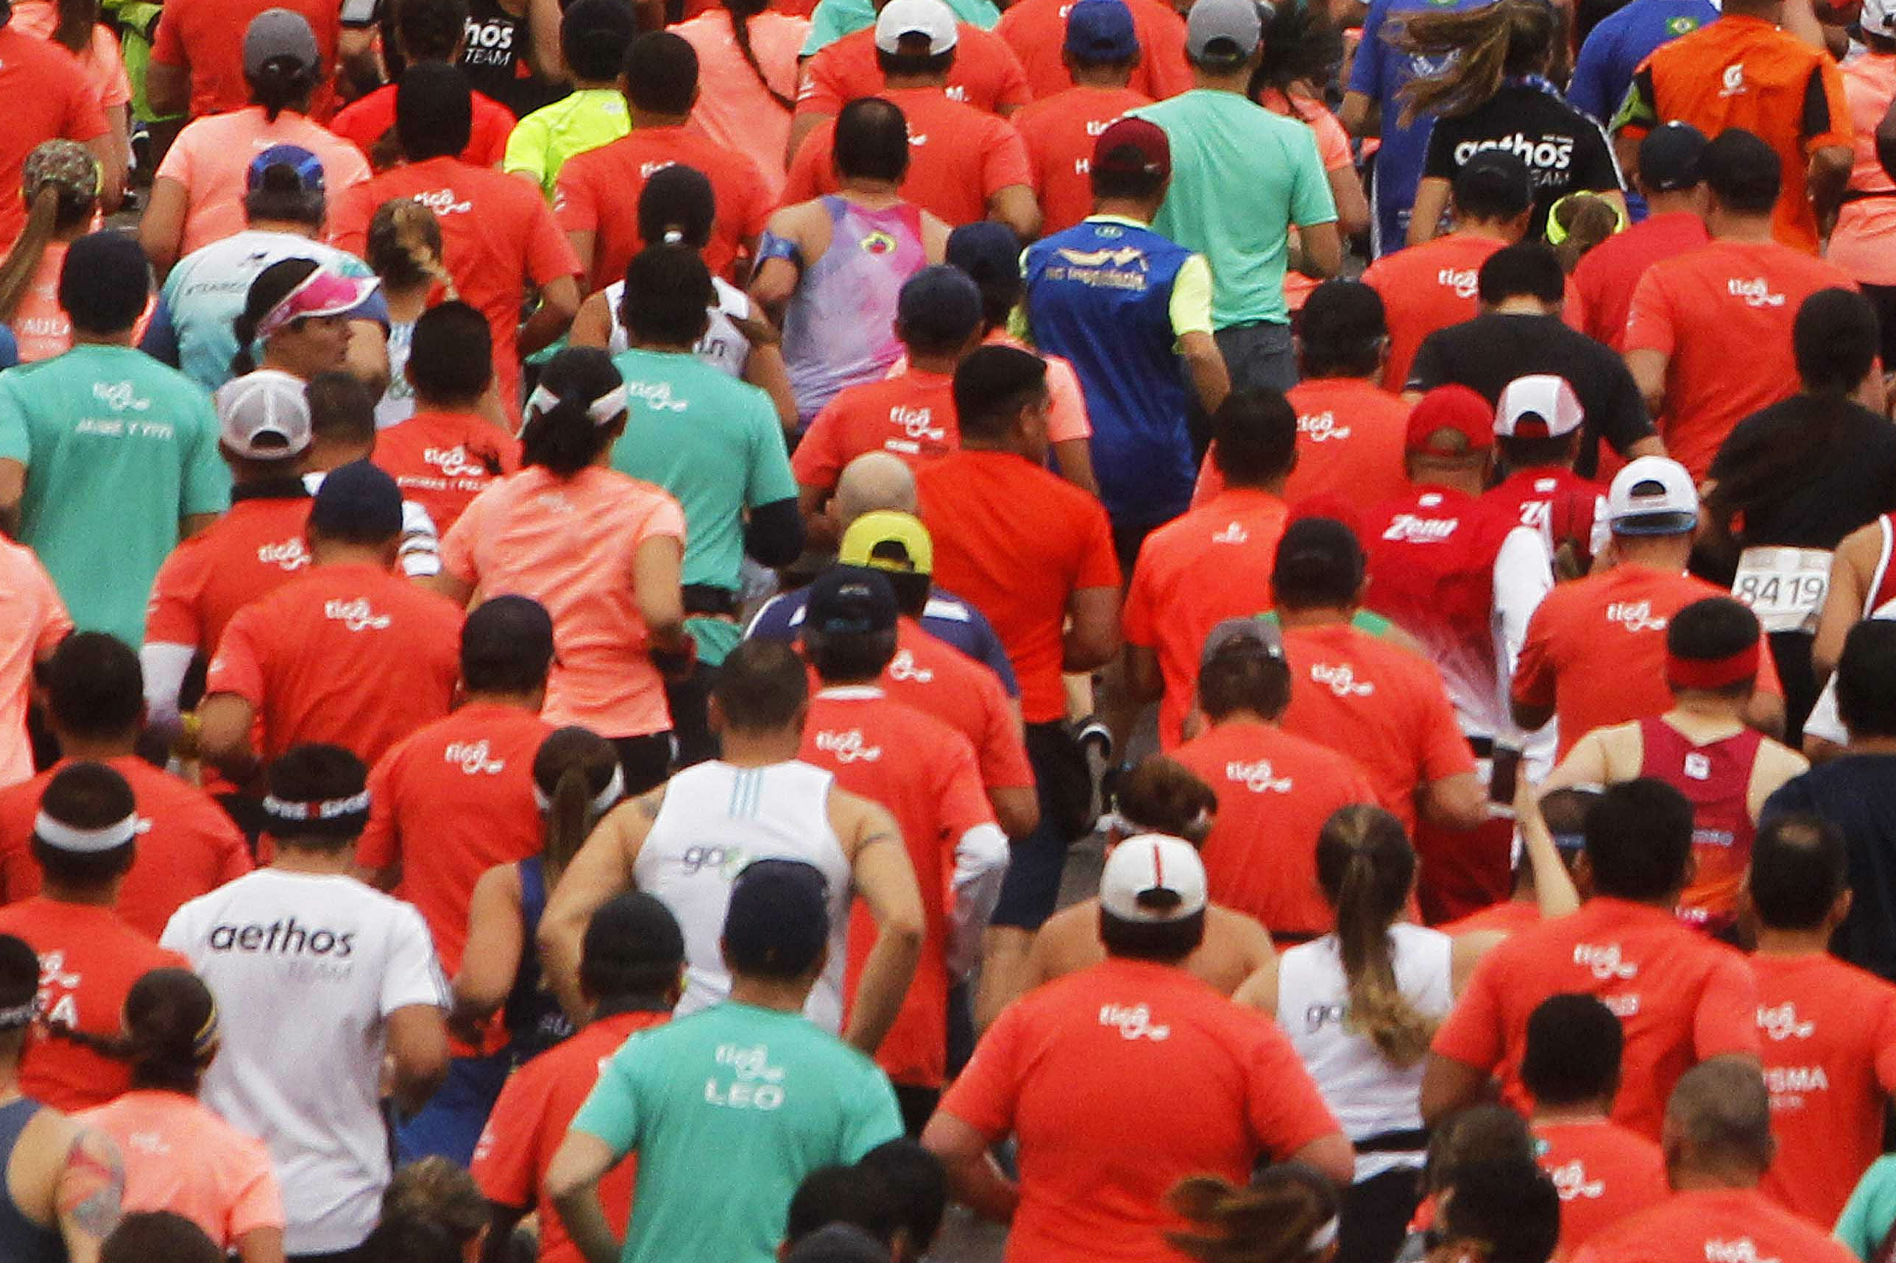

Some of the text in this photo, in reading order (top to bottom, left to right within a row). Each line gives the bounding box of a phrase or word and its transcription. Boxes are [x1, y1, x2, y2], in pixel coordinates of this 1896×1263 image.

[1739, 570, 1825, 607] 8419
[211, 917, 357, 958] aethos
[705, 1079, 785, 1111] LEO
